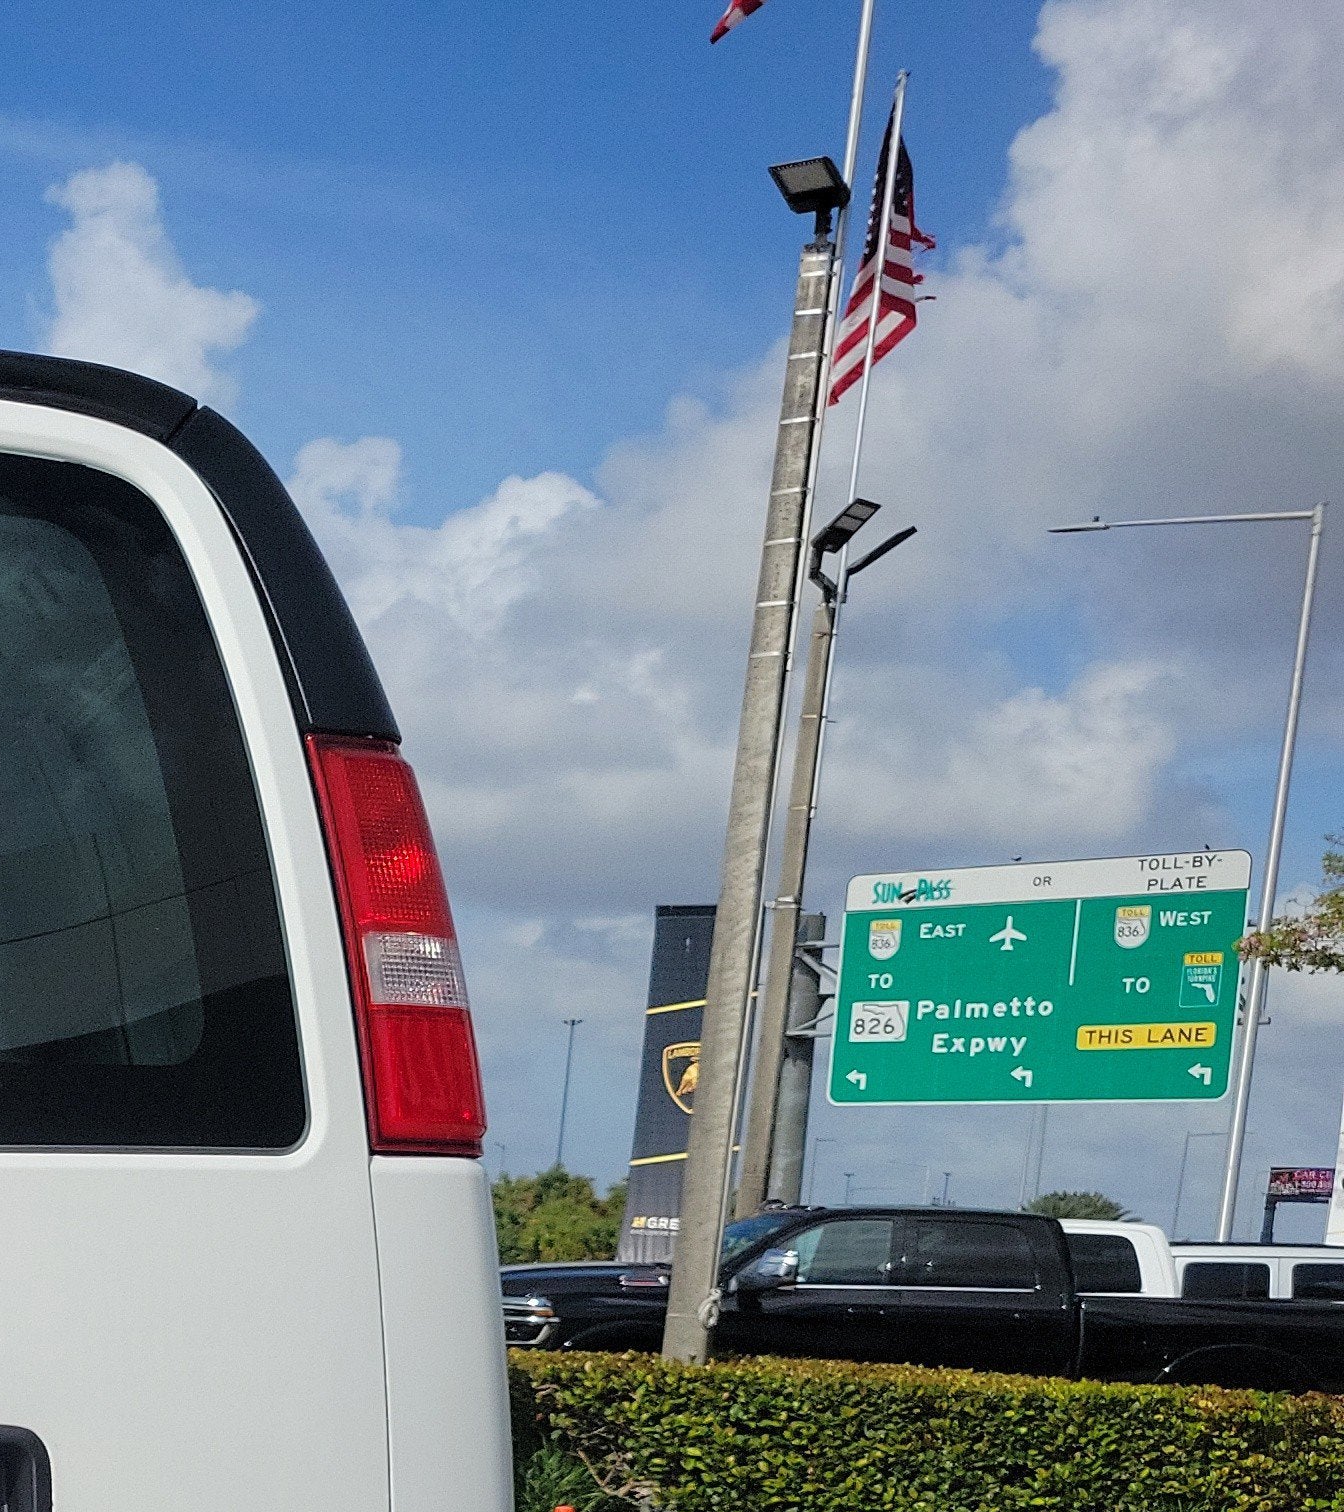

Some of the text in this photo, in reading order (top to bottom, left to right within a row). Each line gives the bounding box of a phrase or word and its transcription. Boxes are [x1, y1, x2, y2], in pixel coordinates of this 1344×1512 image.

[1138, 855, 1223, 871] TOLL-BY-
[1032, 876, 1052, 887] OR
[1147, 876, 1208, 891] PLATE
[1122, 908, 1144, 917] TOLL
[919, 922, 966, 939] EAST
[1118, 925, 1139, 938] 836
[1189, 954, 1217, 963] TOLL
[868, 973, 893, 989] TO
[1122, 977, 1151, 994] TO
[916, 996, 1054, 1020] Palmetto
[854, 1018, 895, 1035] 826
[1085, 1027, 1208, 1045] THIS LANE
[931, 1033, 1027, 1057] Expwy
